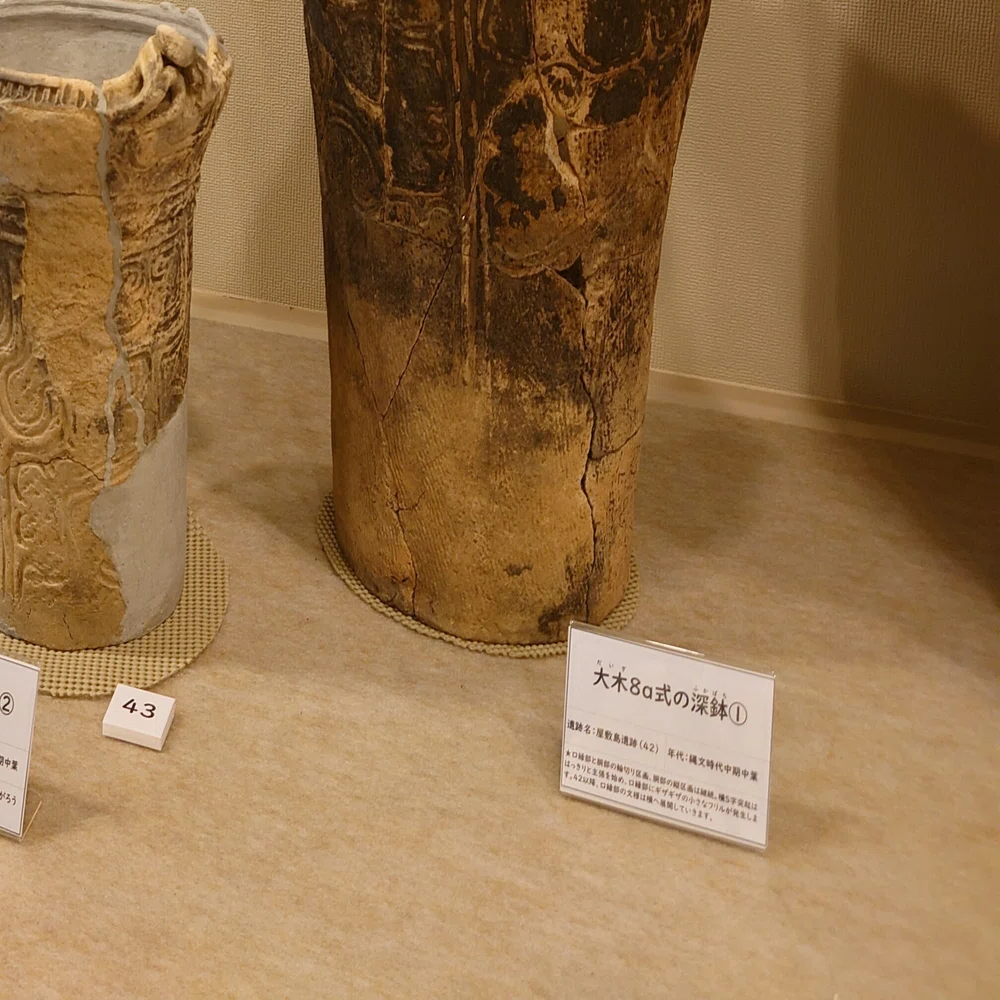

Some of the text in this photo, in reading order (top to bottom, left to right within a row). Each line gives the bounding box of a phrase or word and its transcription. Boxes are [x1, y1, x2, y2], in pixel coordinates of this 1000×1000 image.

[122, 698, 157, 719] 43
[593, 667, 748, 726] 大木8a式の深鉢①
